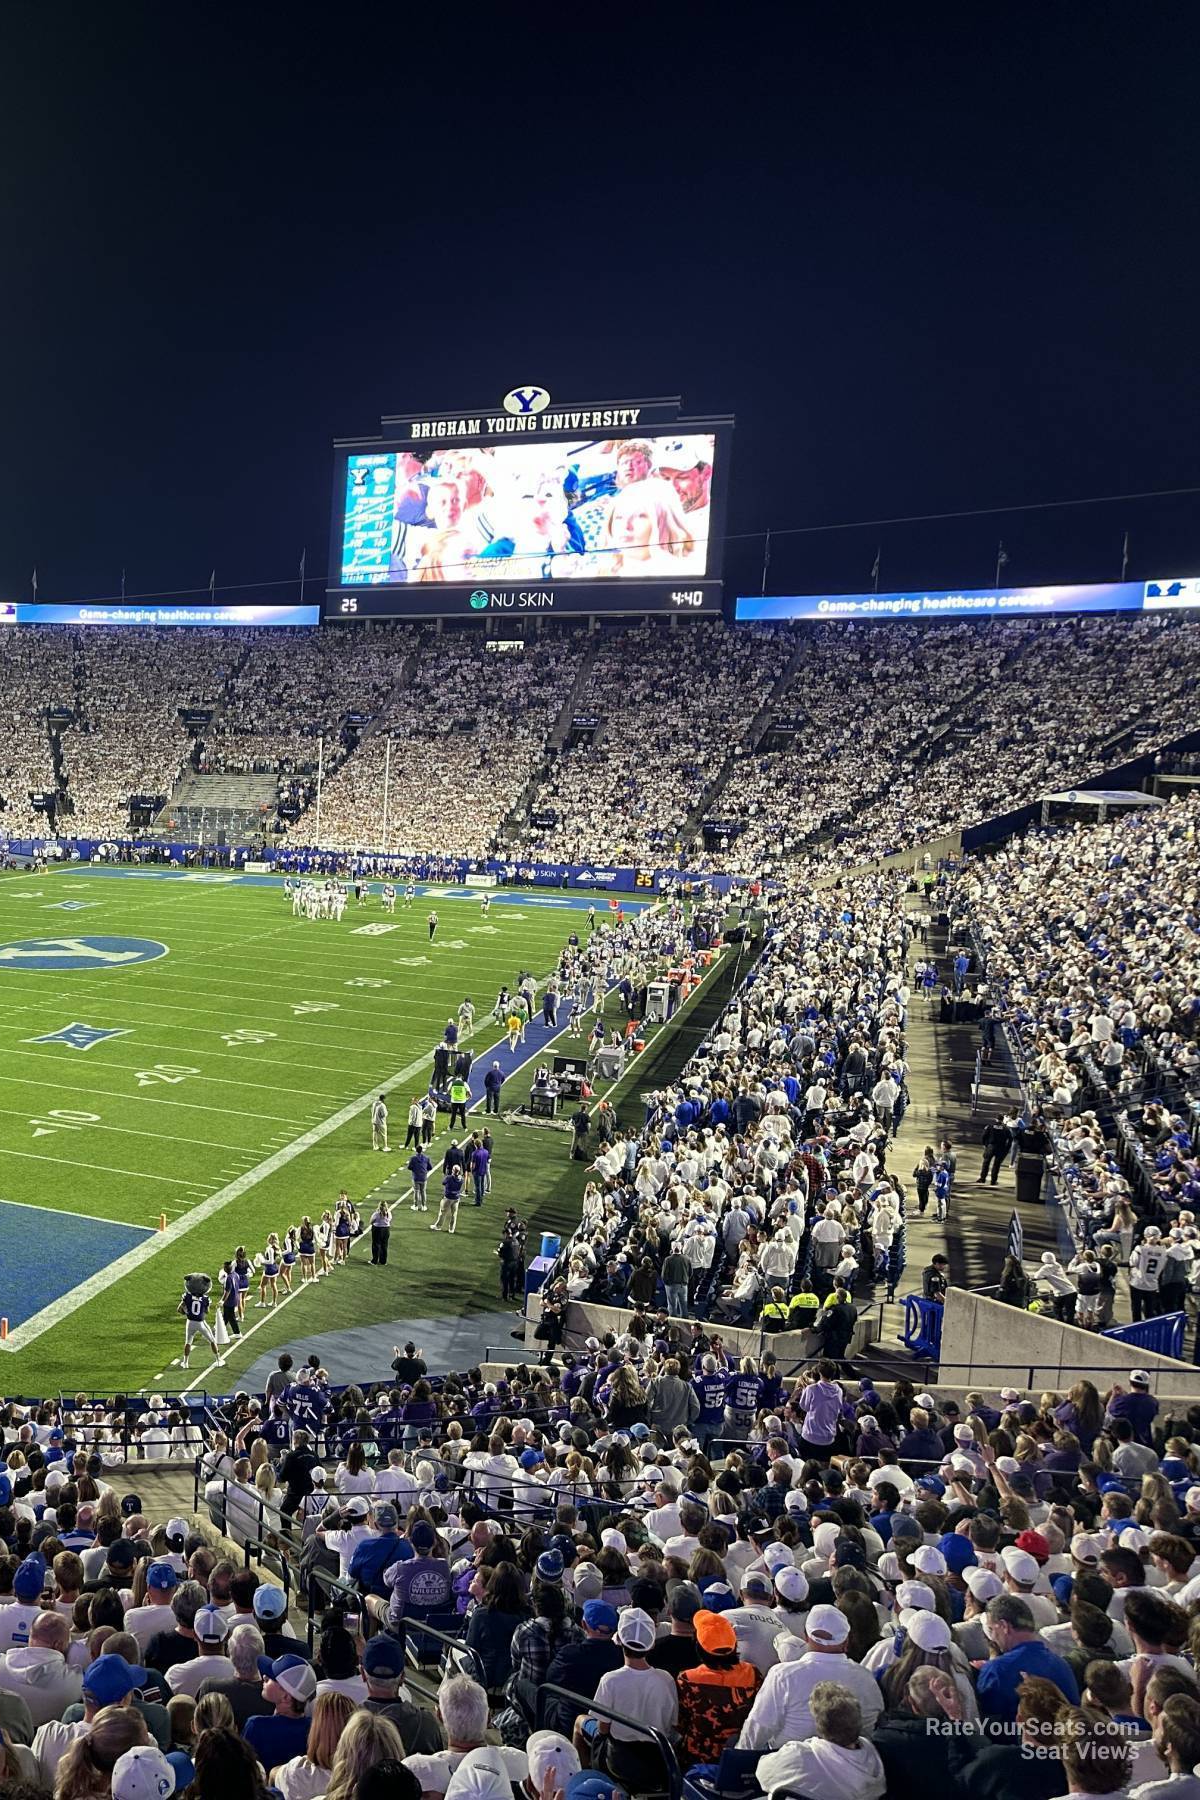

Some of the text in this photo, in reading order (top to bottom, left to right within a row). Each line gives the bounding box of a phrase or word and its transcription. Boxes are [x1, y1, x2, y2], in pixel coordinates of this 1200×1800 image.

[511, 389, 542, 413] Y
[411, 409, 641, 438] BRIGHAM YOUNG UNIVERSITY
[340, 598, 358, 612] 25
[490, 592, 554, 607] NU SKIN
[671, 591, 704, 606] 4:40
[636, 874, 653, 887] 25
[134, 1064, 201, 1084] 20
[538, 1069, 548, 1081] 17
[27, 1109, 101, 1131] 10
[1146, 1258, 1158, 1274] 2
[191, 1301, 201, 1316] 0
[704, 1391, 723, 1408] 56
[737, 1388, 756, 1406] 56
[292, 1400, 312, 1418] 77
[277, 1425, 285, 1439] 0
